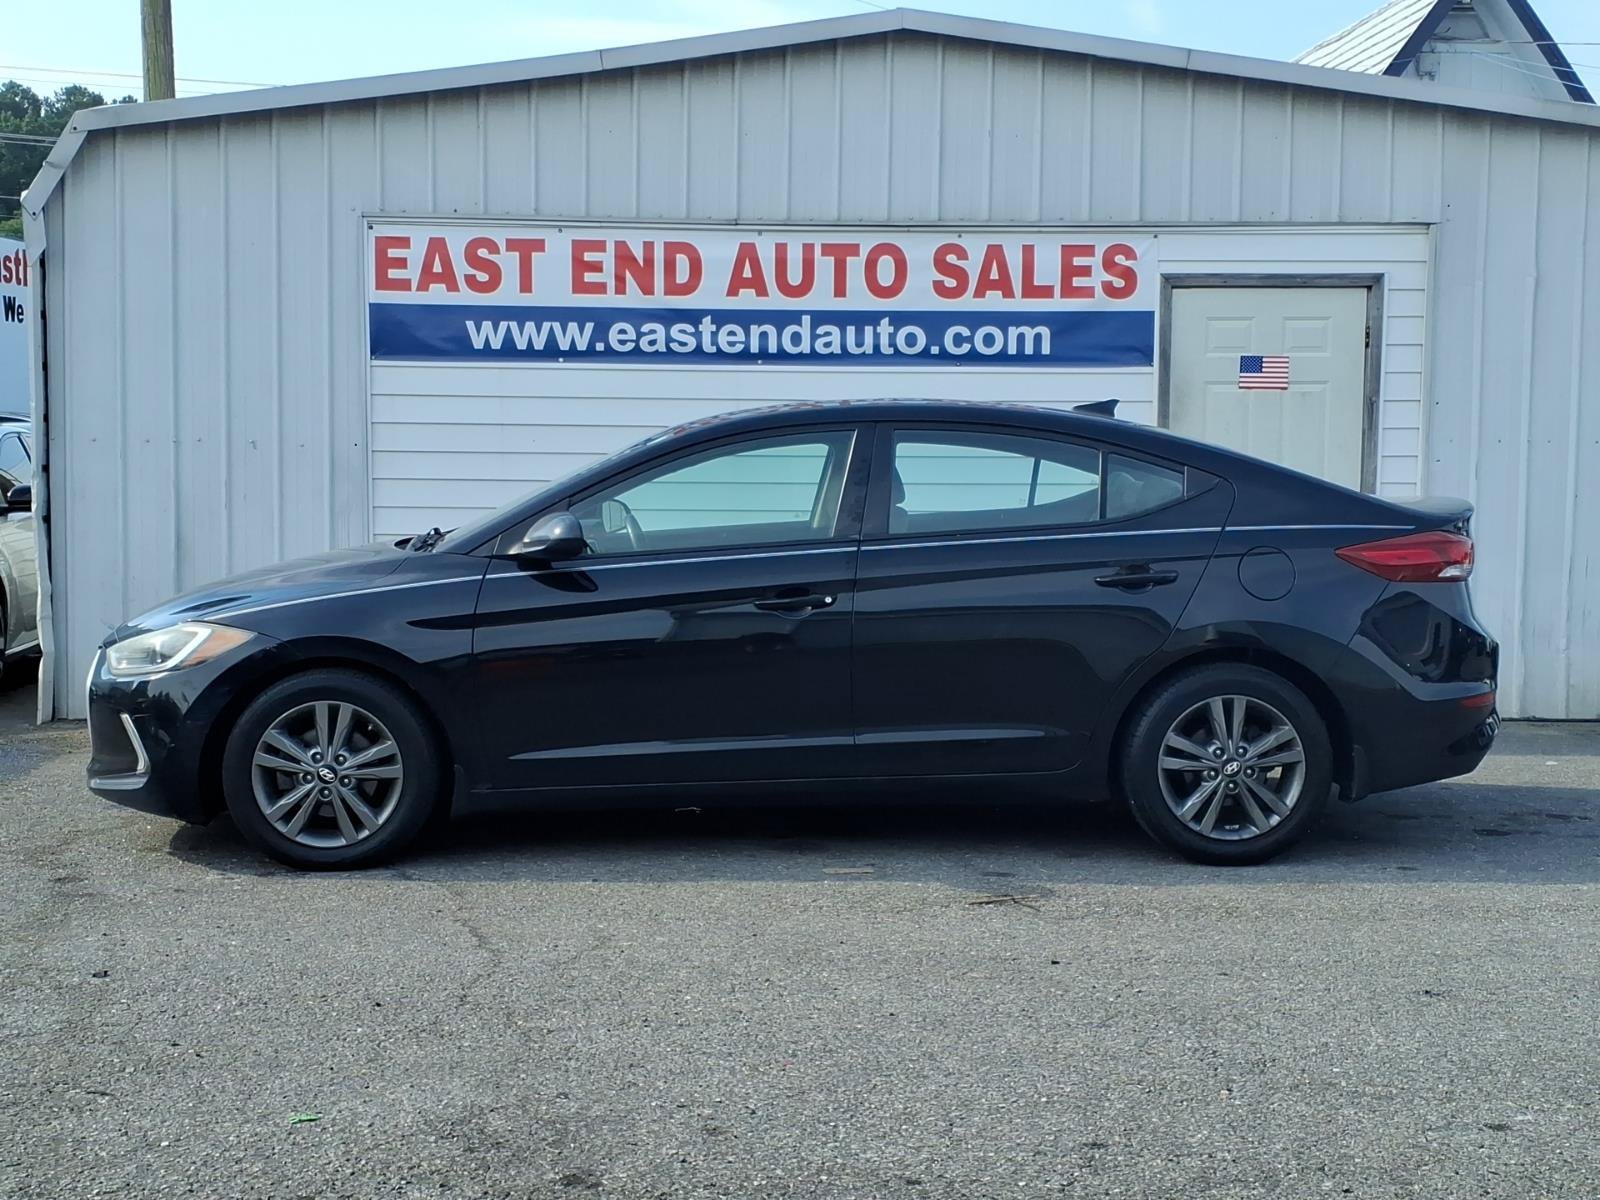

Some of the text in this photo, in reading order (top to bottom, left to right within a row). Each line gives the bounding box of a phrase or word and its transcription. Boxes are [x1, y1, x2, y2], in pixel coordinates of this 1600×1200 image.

[374, 236, 1138, 300] EAST END AUTO SALES
[465, 315, 1052, 356] www.eastendauto.com
